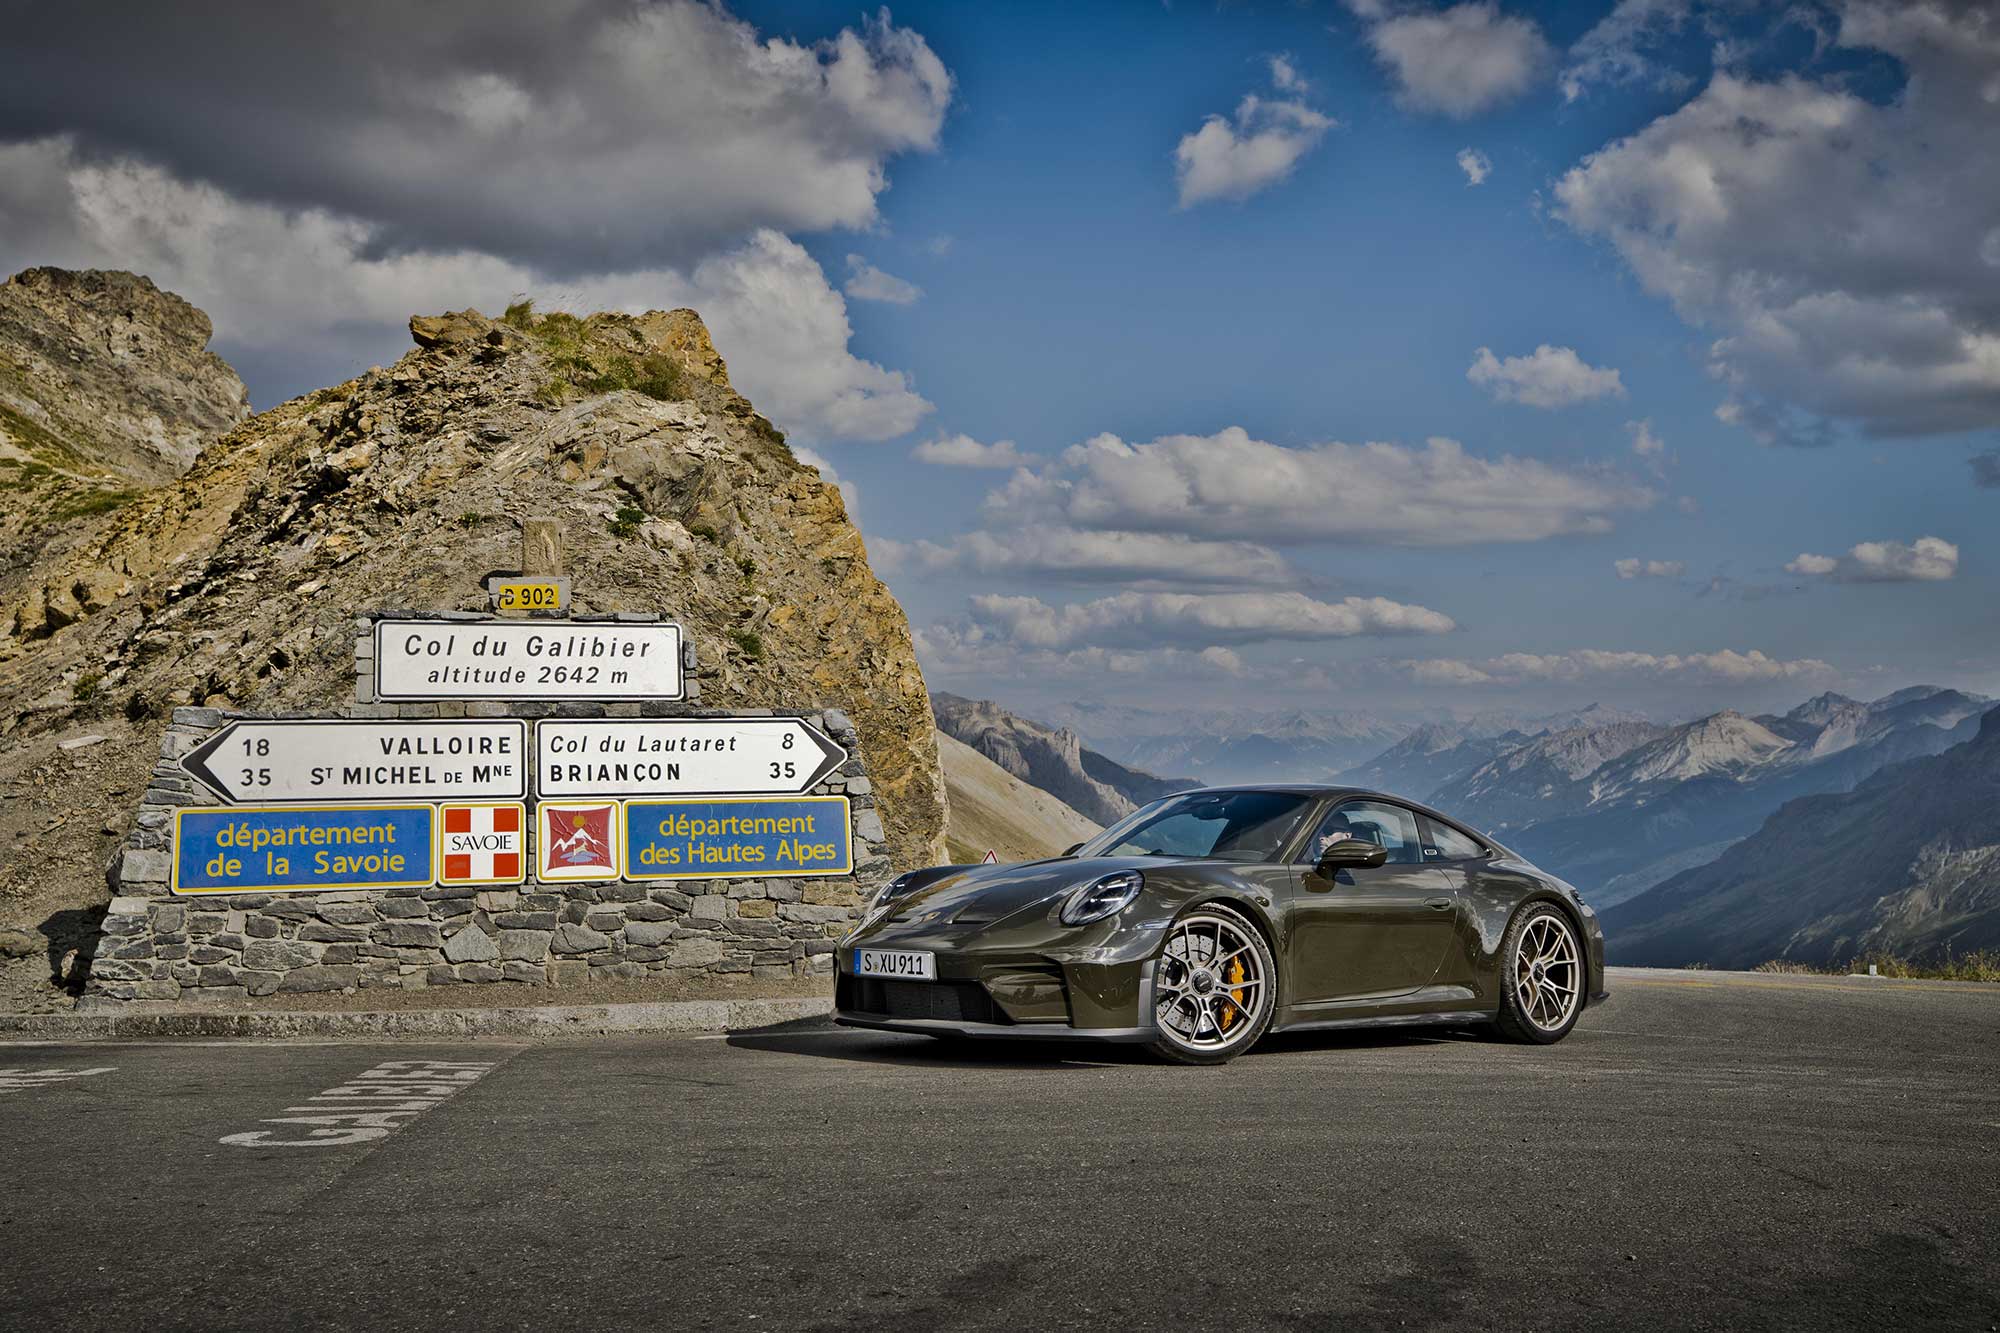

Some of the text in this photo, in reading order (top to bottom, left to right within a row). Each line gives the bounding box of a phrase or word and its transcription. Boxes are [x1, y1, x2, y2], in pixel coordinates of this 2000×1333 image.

[504, 588, 555, 606] D 902
[405, 635, 649, 657] Col du Galibier
[428, 666, 627, 683] altitude 2642 m
[243, 737, 510, 756] 18 VALLOIRE
[551, 733, 793, 752] Col du Lautaret 8
[241, 769, 271, 786] 35
[344, 767, 435, 784] MICHEL
[551, 763, 795, 782] BRIANÇON 35
[659, 814, 815, 837] département
[216, 822, 396, 852] département
[452, 835, 511, 850] SAVOIE
[640, 839, 836, 865] des Hautes Alpes
[206, 850, 405, 877] de la Savoie
[219, 1060, 497, 1147] GALIBIER
